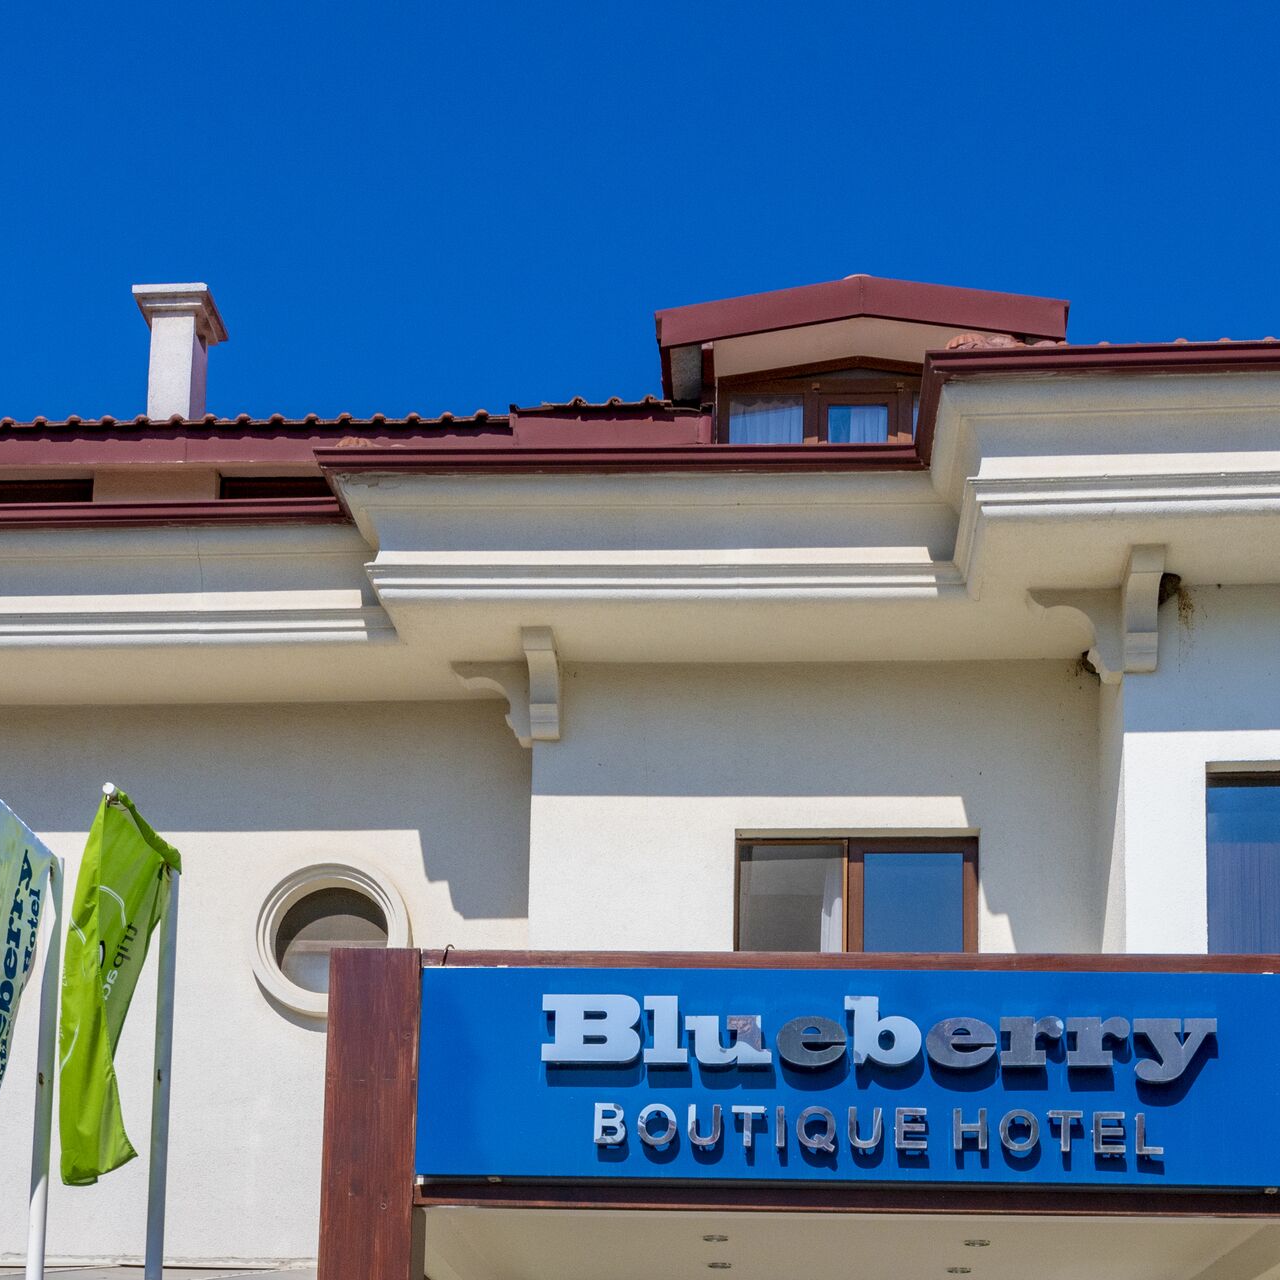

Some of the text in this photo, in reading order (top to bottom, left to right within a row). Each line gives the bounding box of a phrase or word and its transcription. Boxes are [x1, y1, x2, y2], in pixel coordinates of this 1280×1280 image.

[22, 889, 40, 974] Hotel
[540, 993, 1217, 1085] Blueberry
[592, 1102, 1164, 1155] BOUTIQUE HOTEL
